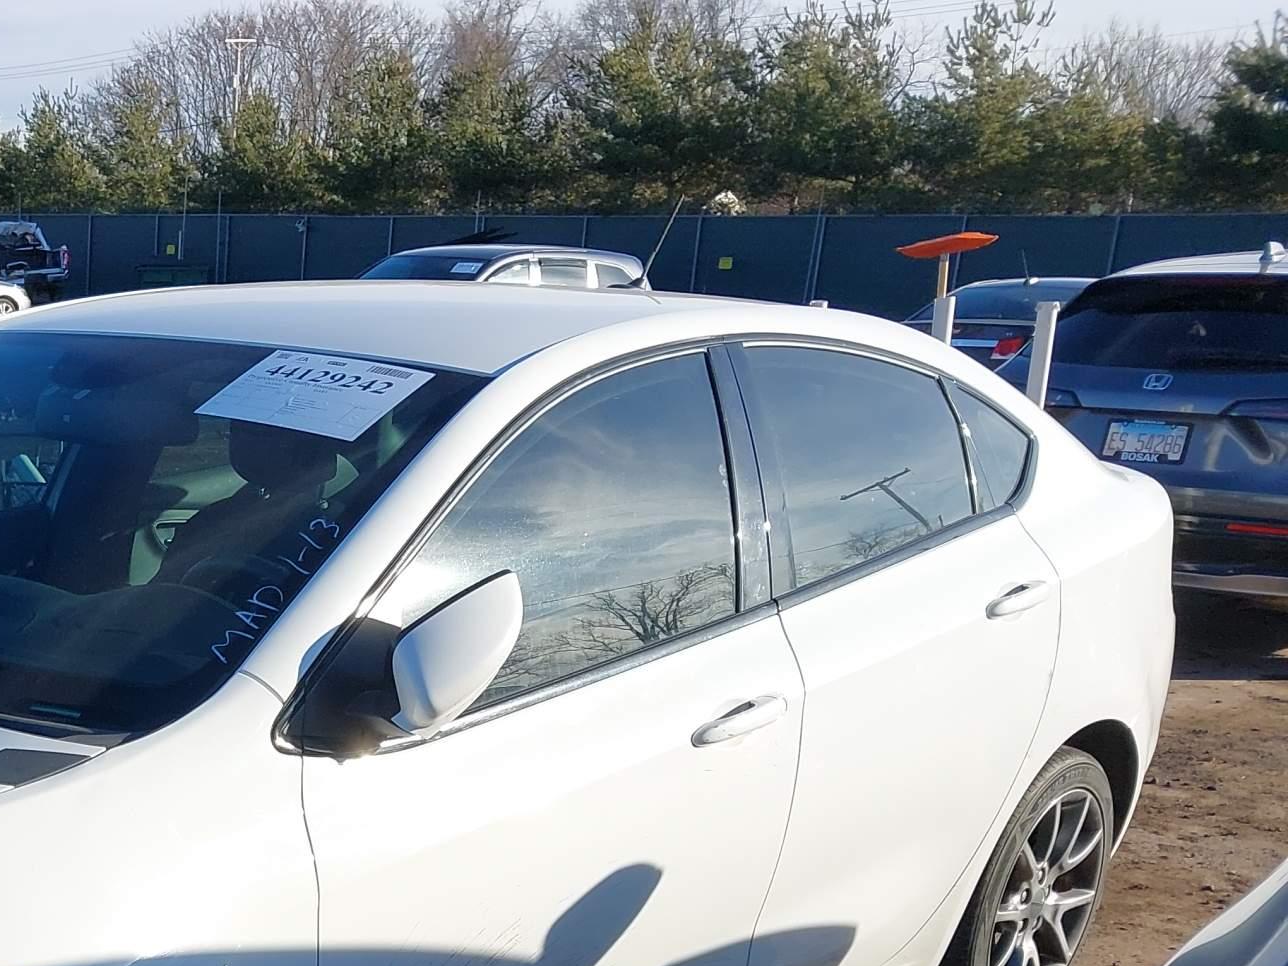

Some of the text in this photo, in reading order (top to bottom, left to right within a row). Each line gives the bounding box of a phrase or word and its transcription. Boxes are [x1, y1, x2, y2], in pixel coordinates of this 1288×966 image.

[264, 364, 395, 395] 44129242
[1120, 452, 1161, 463] BOSAK
[212, 585, 284, 664] MAD
